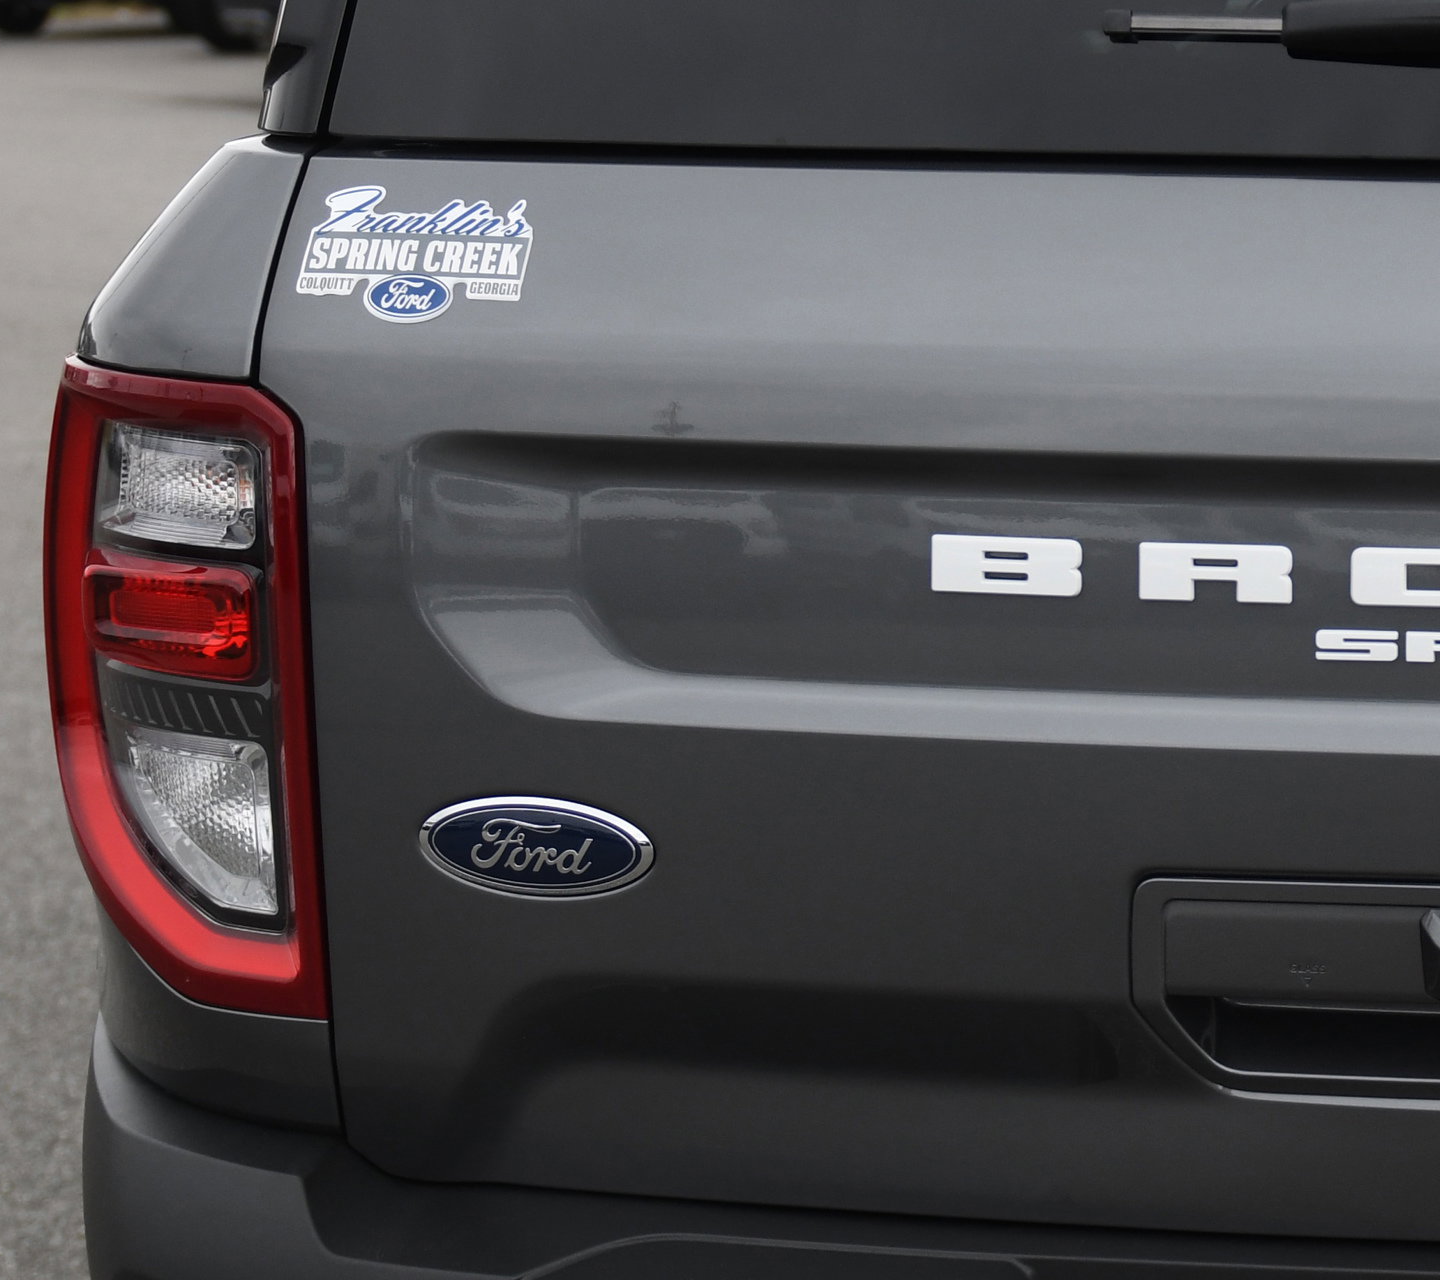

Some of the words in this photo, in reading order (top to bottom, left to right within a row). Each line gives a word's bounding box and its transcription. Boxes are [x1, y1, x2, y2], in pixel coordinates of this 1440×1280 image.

[317, 188, 529, 235] Franklin's
[310, 238, 419, 271] SPRING
[423, 240, 523, 275] CREEK
[299, 276, 354, 291] COLQUITT
[381, 279, 436, 311] Ford
[469, 281, 519, 296] GEORGIA
[471, 818, 594, 875] Ford
